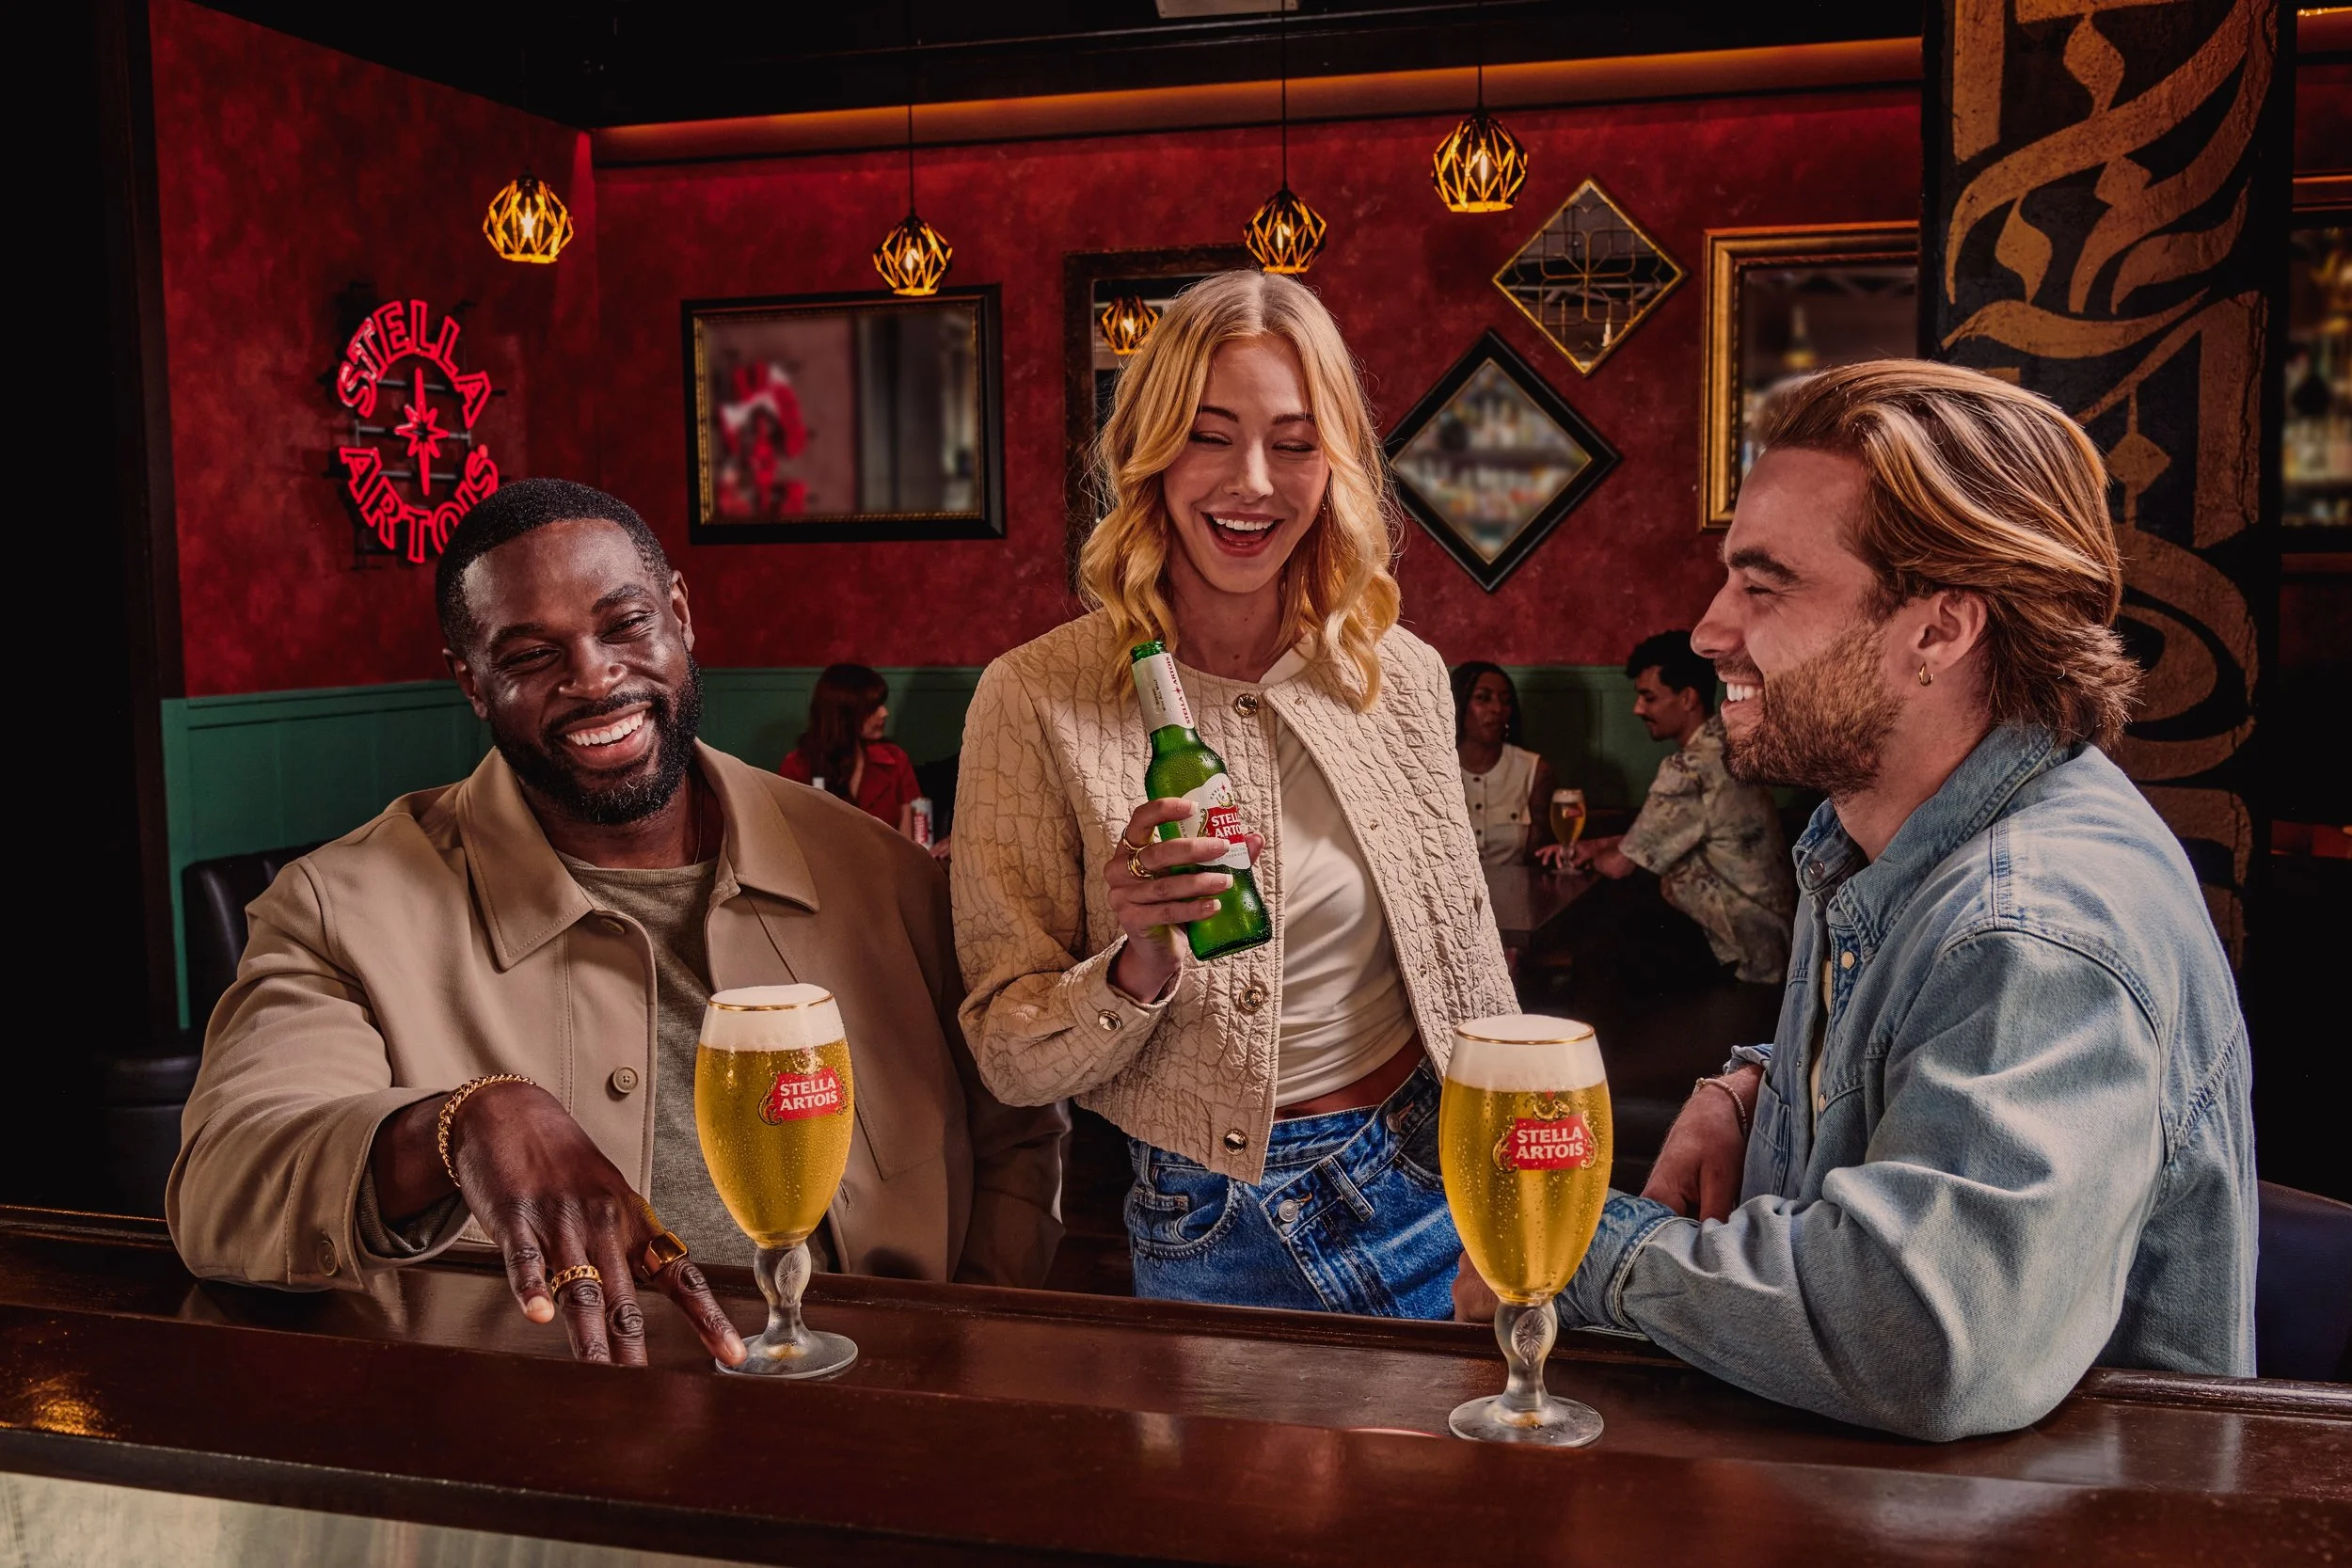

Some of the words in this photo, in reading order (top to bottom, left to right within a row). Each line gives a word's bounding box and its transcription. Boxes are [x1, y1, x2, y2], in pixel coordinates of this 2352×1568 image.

[337, 299, 492, 430] STELLA
[1167, 657, 1178, 685] ARTOIS
[1179, 696, 1191, 724] STELLA
[780, 1077, 836, 1097] STELLA
[780, 1090, 837, 1111] ARTOIS
[1517, 1126, 1583, 1144] STELLA
[1516, 1141, 1585, 1159] ARTOIS
